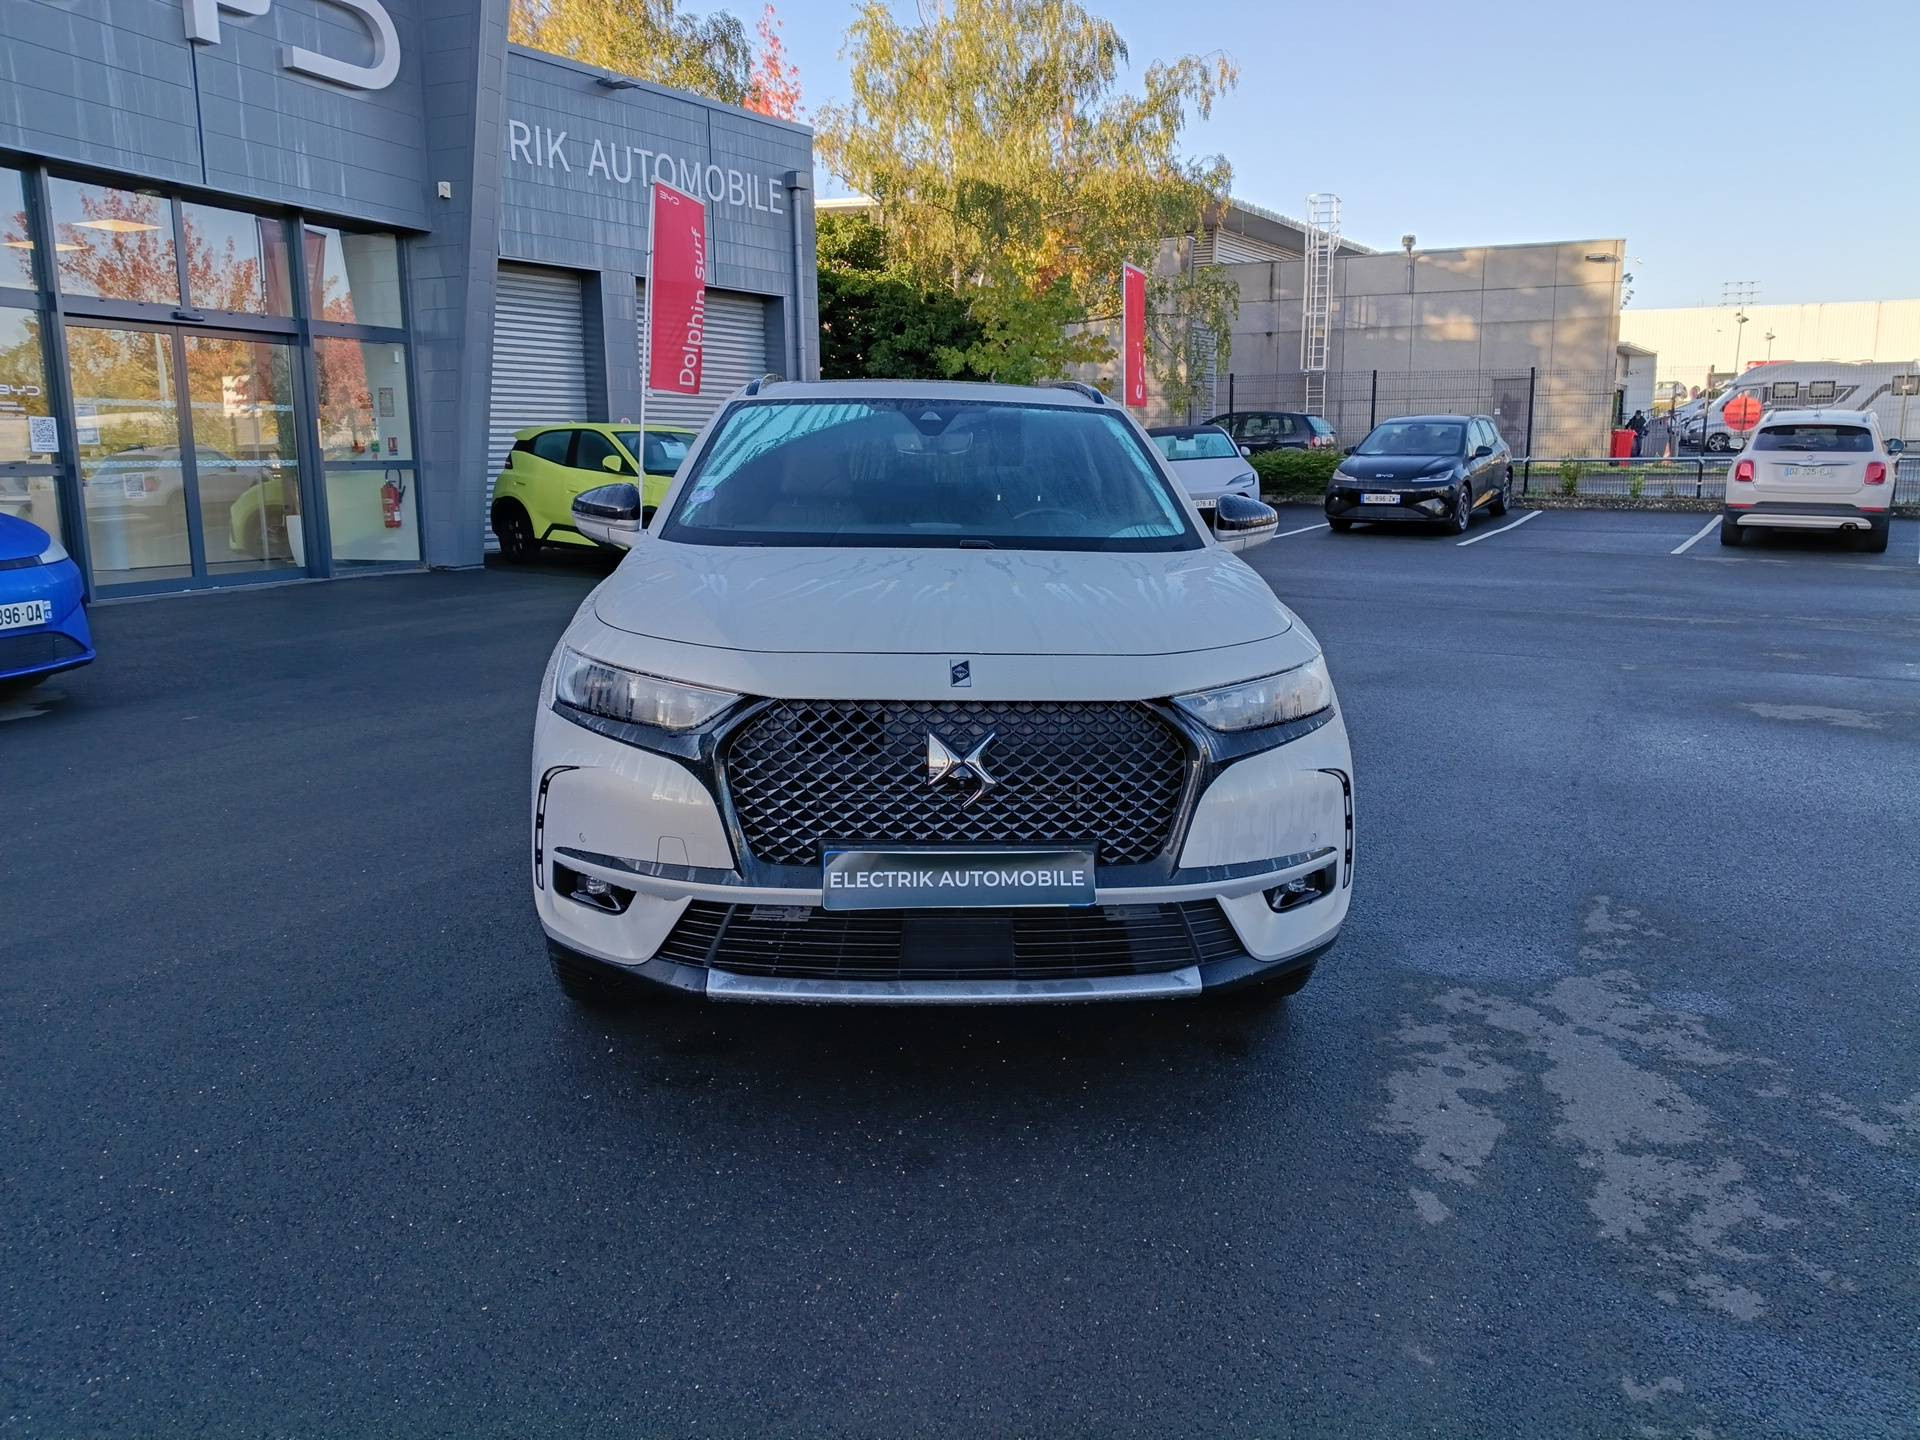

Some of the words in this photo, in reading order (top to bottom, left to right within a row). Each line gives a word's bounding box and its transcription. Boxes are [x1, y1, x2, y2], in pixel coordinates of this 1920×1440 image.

[509, 119, 571, 172] RIK
[588, 139, 784, 215] AUTOMOBILE
[691, 226, 706, 280] surf
[679, 289, 706, 387] Dolphin
[830, 871, 934, 888] ELECTRIK
[939, 870, 1085, 888] AUTOMOBILE
